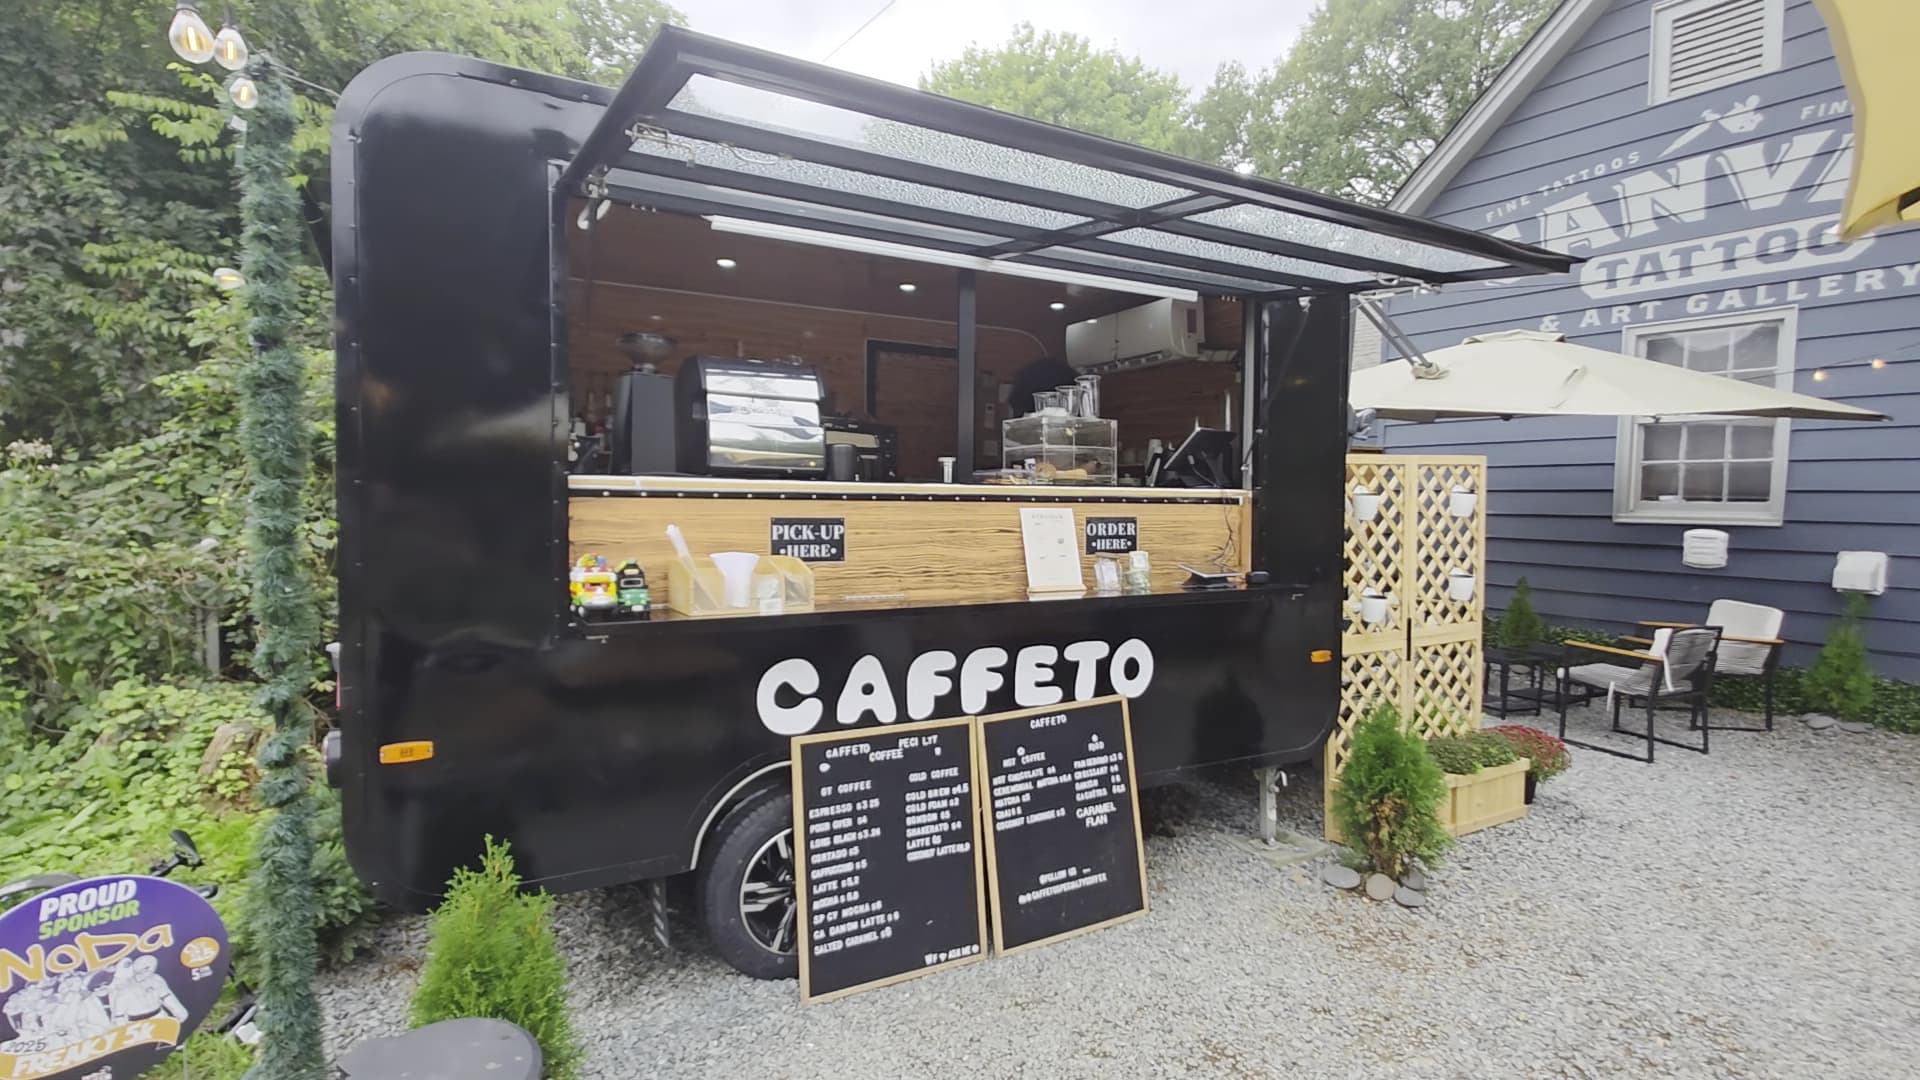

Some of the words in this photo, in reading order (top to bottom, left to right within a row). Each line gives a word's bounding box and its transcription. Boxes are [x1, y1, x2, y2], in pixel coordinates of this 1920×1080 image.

[1801, 99, 1855, 121] FIN
[1485, 196, 1531, 223] FINE
[1538, 151, 1640, 197] TATTOOS
[1484, 130, 1855, 286] ANV
[1596, 220, 1852, 290] TATTOO
[1539, 315, 1560, 332] &
[1579, 300, 1664, 328] ART
[1686, 263, 1920, 314] GALLERY
[772, 524, 845, 541] PICK-UP
[1086, 522, 1136, 536] ORDER
[757, 638, 1154, 736] CAFFETO
[1030, 714, 1067, 729] CAFFETO
[869, 748, 904, 762] COFFEE
[1021, 751, 1046, 765] COFFEE
[930, 766, 959, 779] COFFEE
[837, 780, 872, 794] COFFEE
[905, 790, 926, 802] COLD
[808, 802, 853, 819] ESPRESSO
[905, 802, 927, 814] COLD
[1076, 801, 1117, 819] CARAMEL
[1085, 814, 1108, 828] FLAN
[906, 837, 931, 850] LATTE
[812, 880, 838, 895] LATTE
[38, 880, 138, 921] PROUD
[38, 900, 141, 940] SPONSOR
[860, 913, 887, 929] LATTE
[0, 924, 174, 993] NoDa
[122, 1022, 155, 1044] 5K
